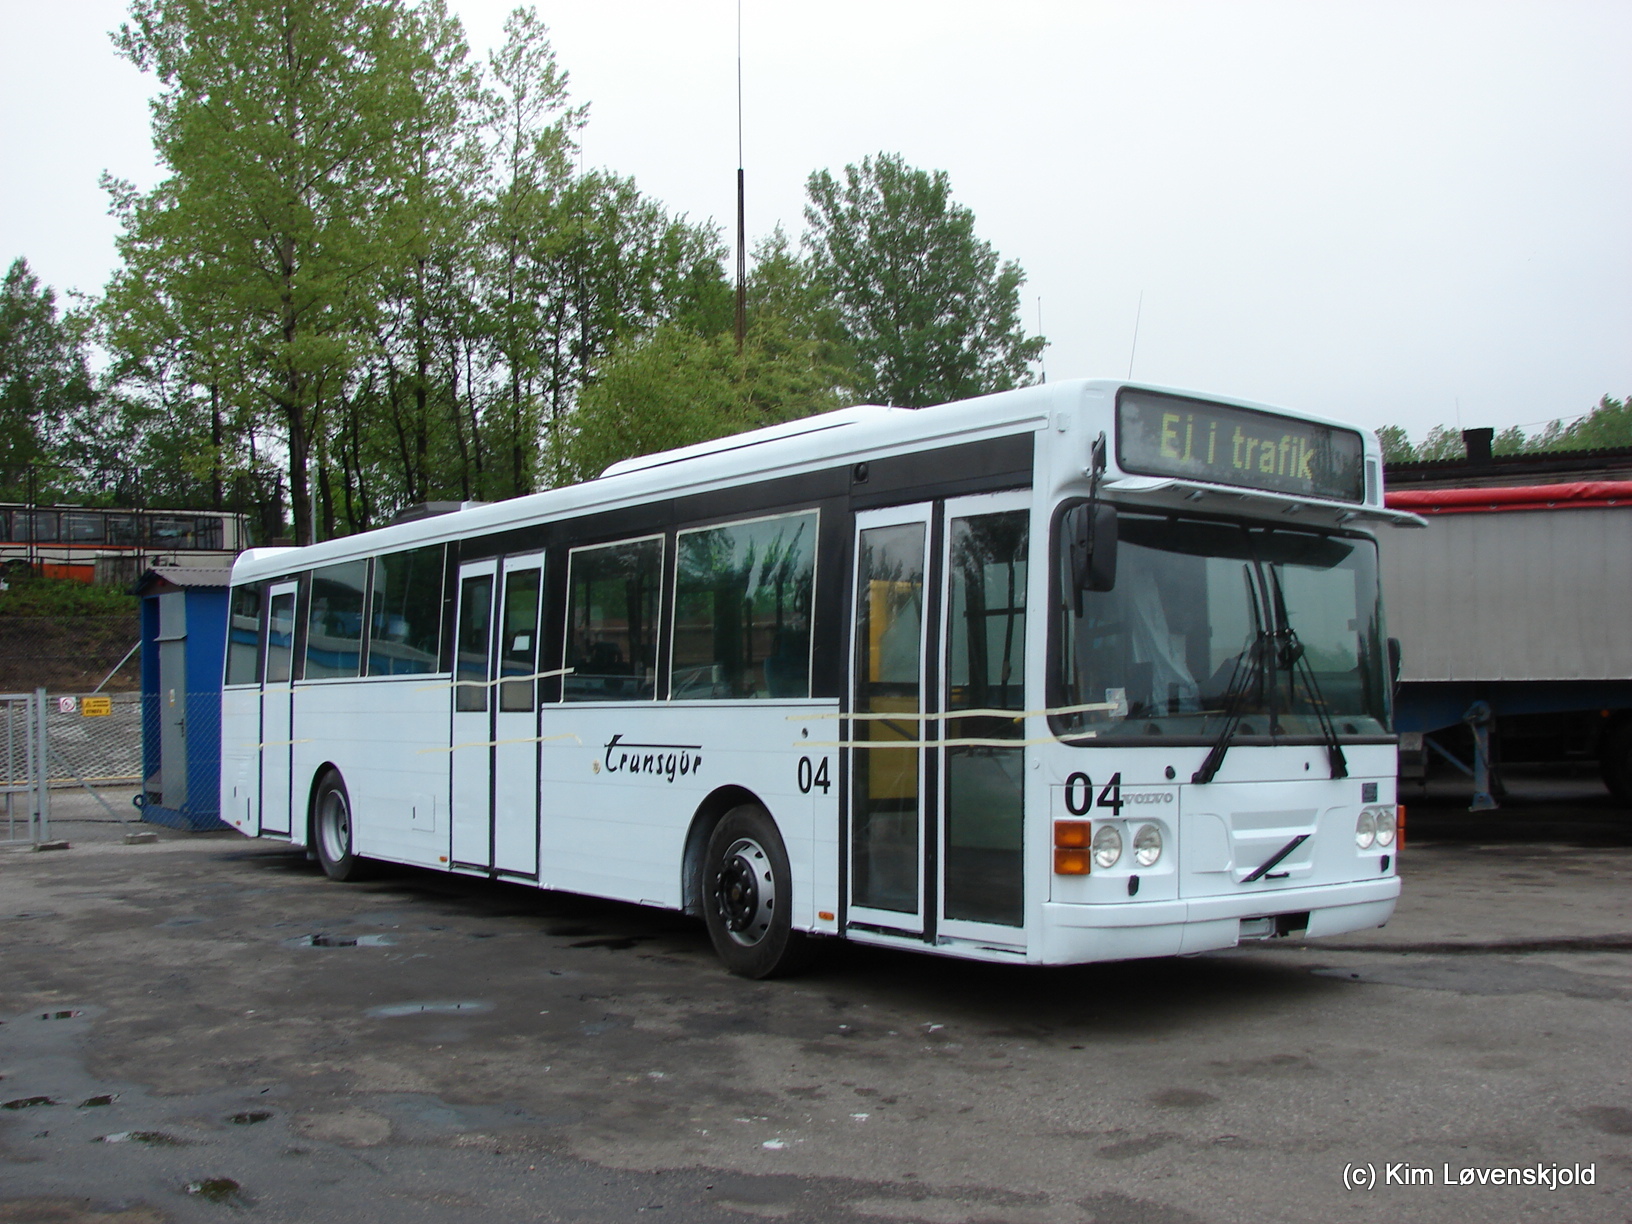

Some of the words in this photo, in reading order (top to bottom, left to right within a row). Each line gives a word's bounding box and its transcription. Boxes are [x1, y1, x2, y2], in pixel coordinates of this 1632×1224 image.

[1160, 413, 1193, 464] Ej
[1207, 421, 1216, 465] i
[1232, 425, 1315, 480] trafik
[797, 755, 831, 795] 04
[1064, 771, 1124, 816] 04
[1121, 792, 1174, 805] VOLVO
